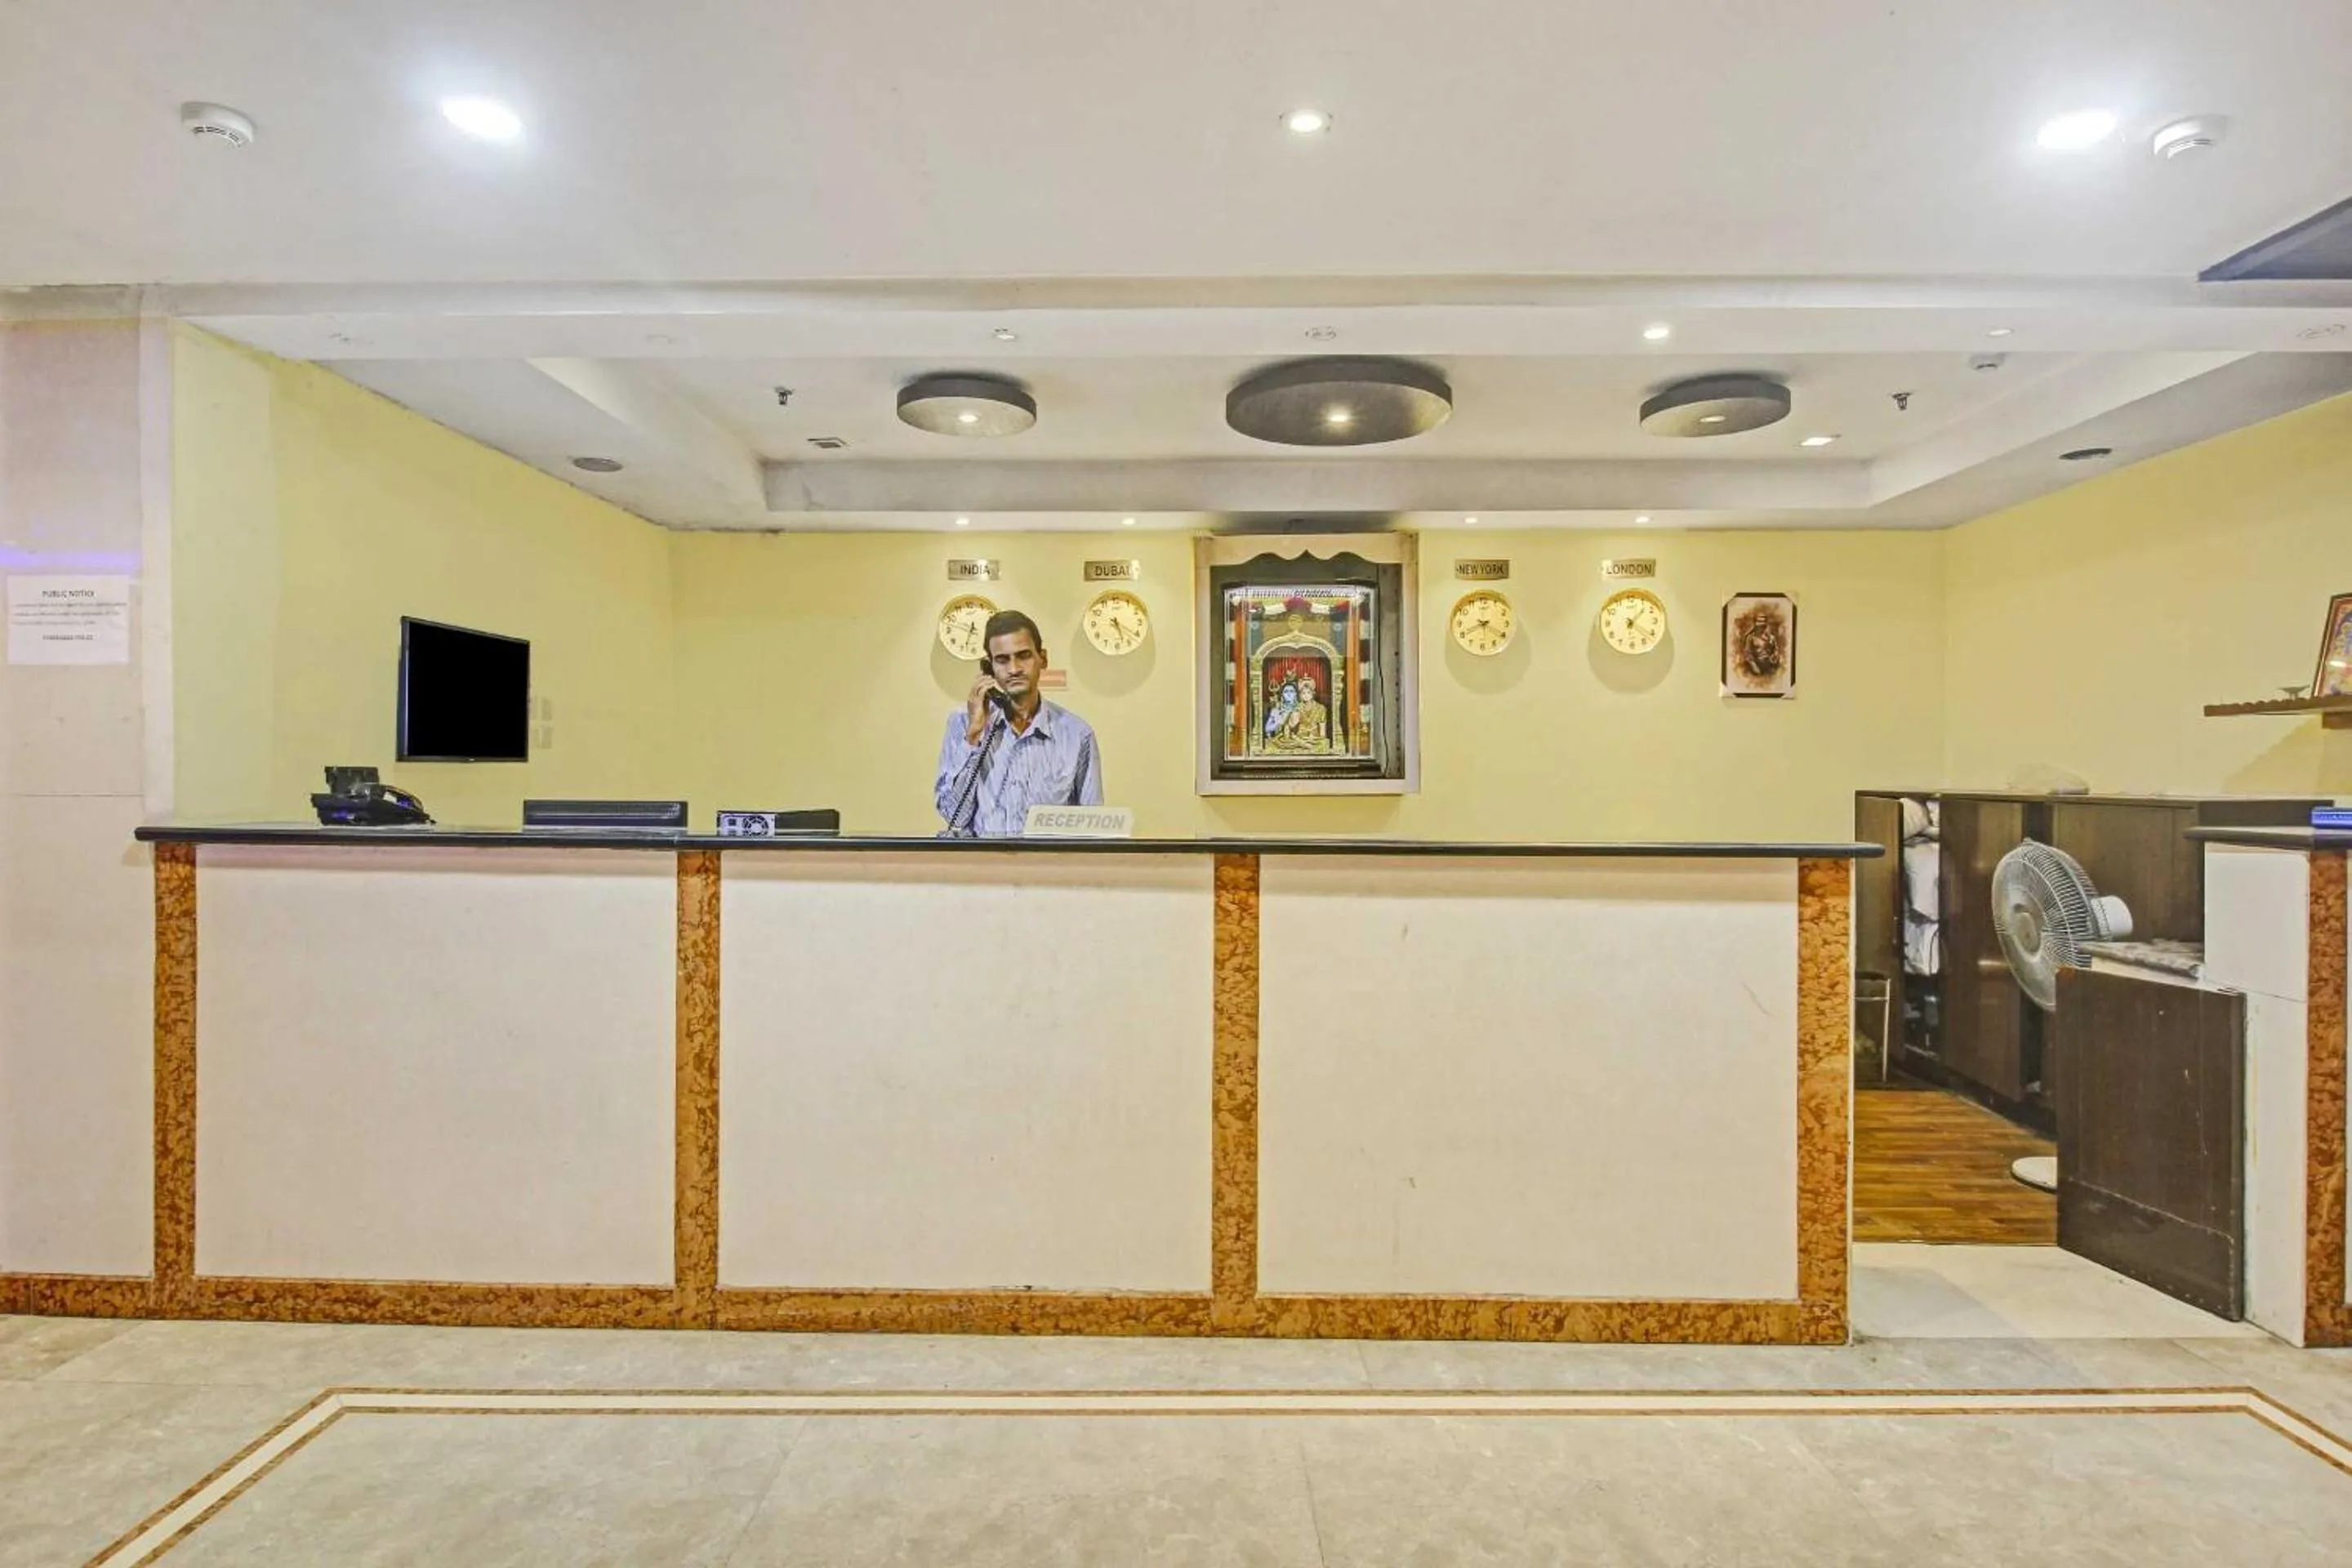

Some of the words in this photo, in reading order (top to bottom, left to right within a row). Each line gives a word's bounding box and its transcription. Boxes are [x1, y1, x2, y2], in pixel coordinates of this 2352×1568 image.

[960, 564, 990, 575] INDIA
[1095, 565, 1130, 576] DUBAI
[1459, 564, 1479, 575] NEW
[1479, 564, 1504, 575] YORK
[1606, 564, 1651, 575] LONDON
[1034, 813, 1125, 829] RECEPTION
